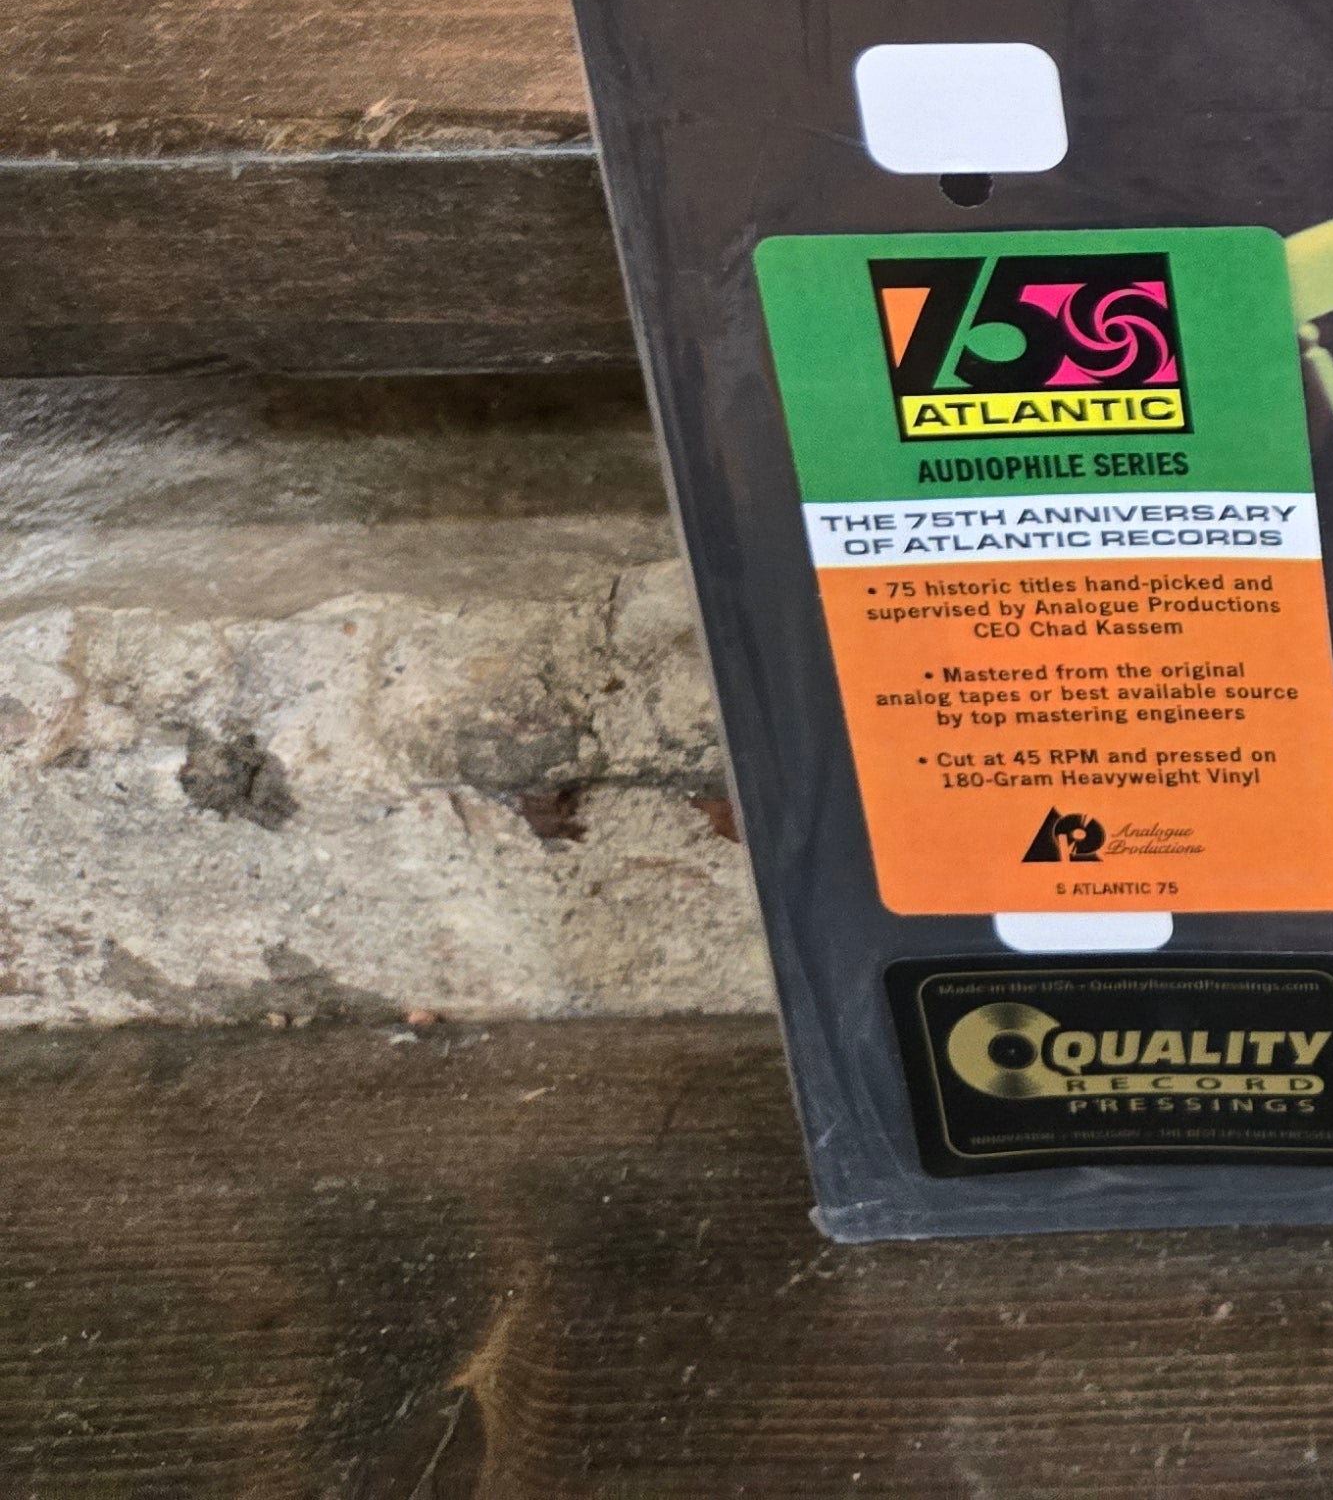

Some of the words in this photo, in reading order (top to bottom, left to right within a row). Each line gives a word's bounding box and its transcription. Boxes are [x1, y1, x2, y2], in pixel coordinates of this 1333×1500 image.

[912, 396, 1177, 427] ATLANTIC
[918, 454, 1086, 484] AUDIOPHILE
[1093, 451, 1189, 477] SERIES
[820, 513, 897, 532] THE
[904, 509, 1006, 529] 75TH
[1016, 505, 1296, 526] ANNIVERSARY
[843, 539, 895, 556] OF
[903, 531, 1092, 553] ATLANTIC
[1101, 529, 1283, 548] RECORDS
[886, 583, 915, 598] 75
[925, 578, 1011, 596] historic
[1020, 576, 1076, 593] titles
[1085, 575, 1223, 594] hand-picked
[1233, 575, 1273, 591] and
[867, 599, 990, 623] supervised
[999, 600, 1025, 621] by
[1035, 598, 1139, 619] Analogue
[1148, 597, 1280, 613] Productions
[974, 622, 1019, 639] CEO
[1030, 620, 1087, 637] Chad
[1097, 620, 1183, 636] Kassem
[943, 665, 1048, 682] Mastered
[1055, 664, 1108, 679] from
[1117, 663, 1152, 678] the
[1161, 662, 1244, 680] original
[876, 690, 951, 708] analog
[959, 689, 1021, 706] tapes
[1030, 689, 1052, 702] or
[1061, 685, 1109, 701] best
[1117, 683, 1216, 700] available
[1225, 686, 1299, 700] source
[936, 710, 962, 728] by
[971, 710, 1006, 727] top
[1016, 706, 1127, 725] mastering
[1136, 706, 1245, 723] engineers
[937, 752, 975, 767] Cut
[984, 752, 1004, 766] at
[1013, 751, 1041, 765] 45
[1051, 750, 1099, 764] RPM
[1108, 749, 1147, 763] and
[1156, 748, 1241, 767] pressed
[1251, 750, 1276, 763] on
[943, 771, 1053, 788] 180-Gram
[1062, 769, 1201, 788] Heavyweight
[1208, 768, 1261, 787] Vinyl
[1112, 823, 1193, 842] Analogue
[1105, 841, 1205, 855] Productions
[1073, 882, 1151, 895] ATLANTIC
[1158, 881, 1179, 895] 75
[1052, 1031, 1332, 1075] QUALITY
[1067, 1076, 1314, 1093] RECORD
[1070, 1098, 1316, 1114] PRESSINGS
